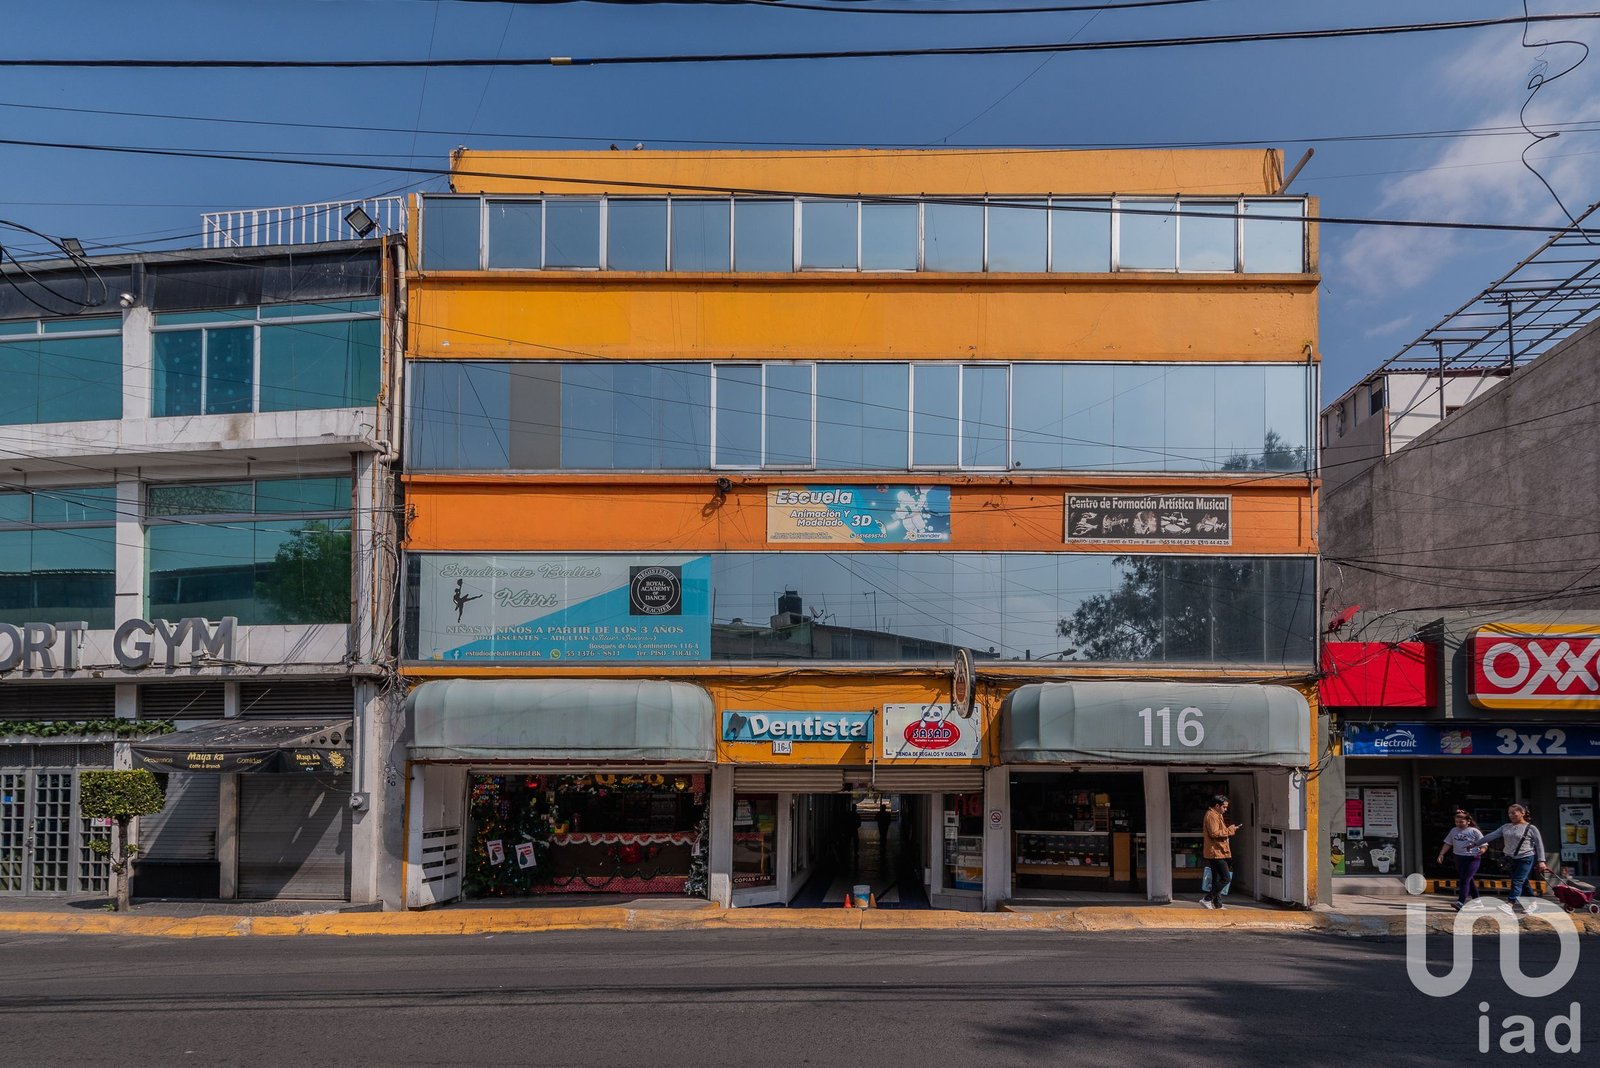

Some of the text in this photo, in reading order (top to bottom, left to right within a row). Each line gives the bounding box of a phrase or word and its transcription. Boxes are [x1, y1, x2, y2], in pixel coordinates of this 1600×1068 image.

[776, 489, 853, 505] Escuela
[1070, 496, 1227, 510] Centro de Formación Artística Musical
[790, 509, 851, 518] Animación Y
[797, 518, 843, 527] Modelado
[851, 515, 872, 527] 3D
[440, 562, 602, 579] Estudio de Ballet
[637, 568, 675, 581] REGISTERED
[494, 587, 559, 608] Kitri
[642, 603, 671, 613] TEACHER
[446, 624, 482, 634] NIÑAS
[498, 624, 532, 634] NIÑOS
[535, 626, 544, 634] A
[547, 626, 590, 634] PARTIR
[595, 626, 609, 634] DE
[615, 626, 637, 634] LOS
[641, 626, 648, 634] 3
[652, 624, 684, 634] AÑOS
[113, 617, 237, 668] GYM
[1483, 639, 1600, 696] OXX
[749, 714, 867, 736] Dentista
[1138, 707, 1205, 747] 116
[912, 728, 952, 739] SASAD
[1374, 738, 1416, 748] Electrolit
[1496, 728, 1568, 754] 3x2
[187, 752, 211, 763] Maya
